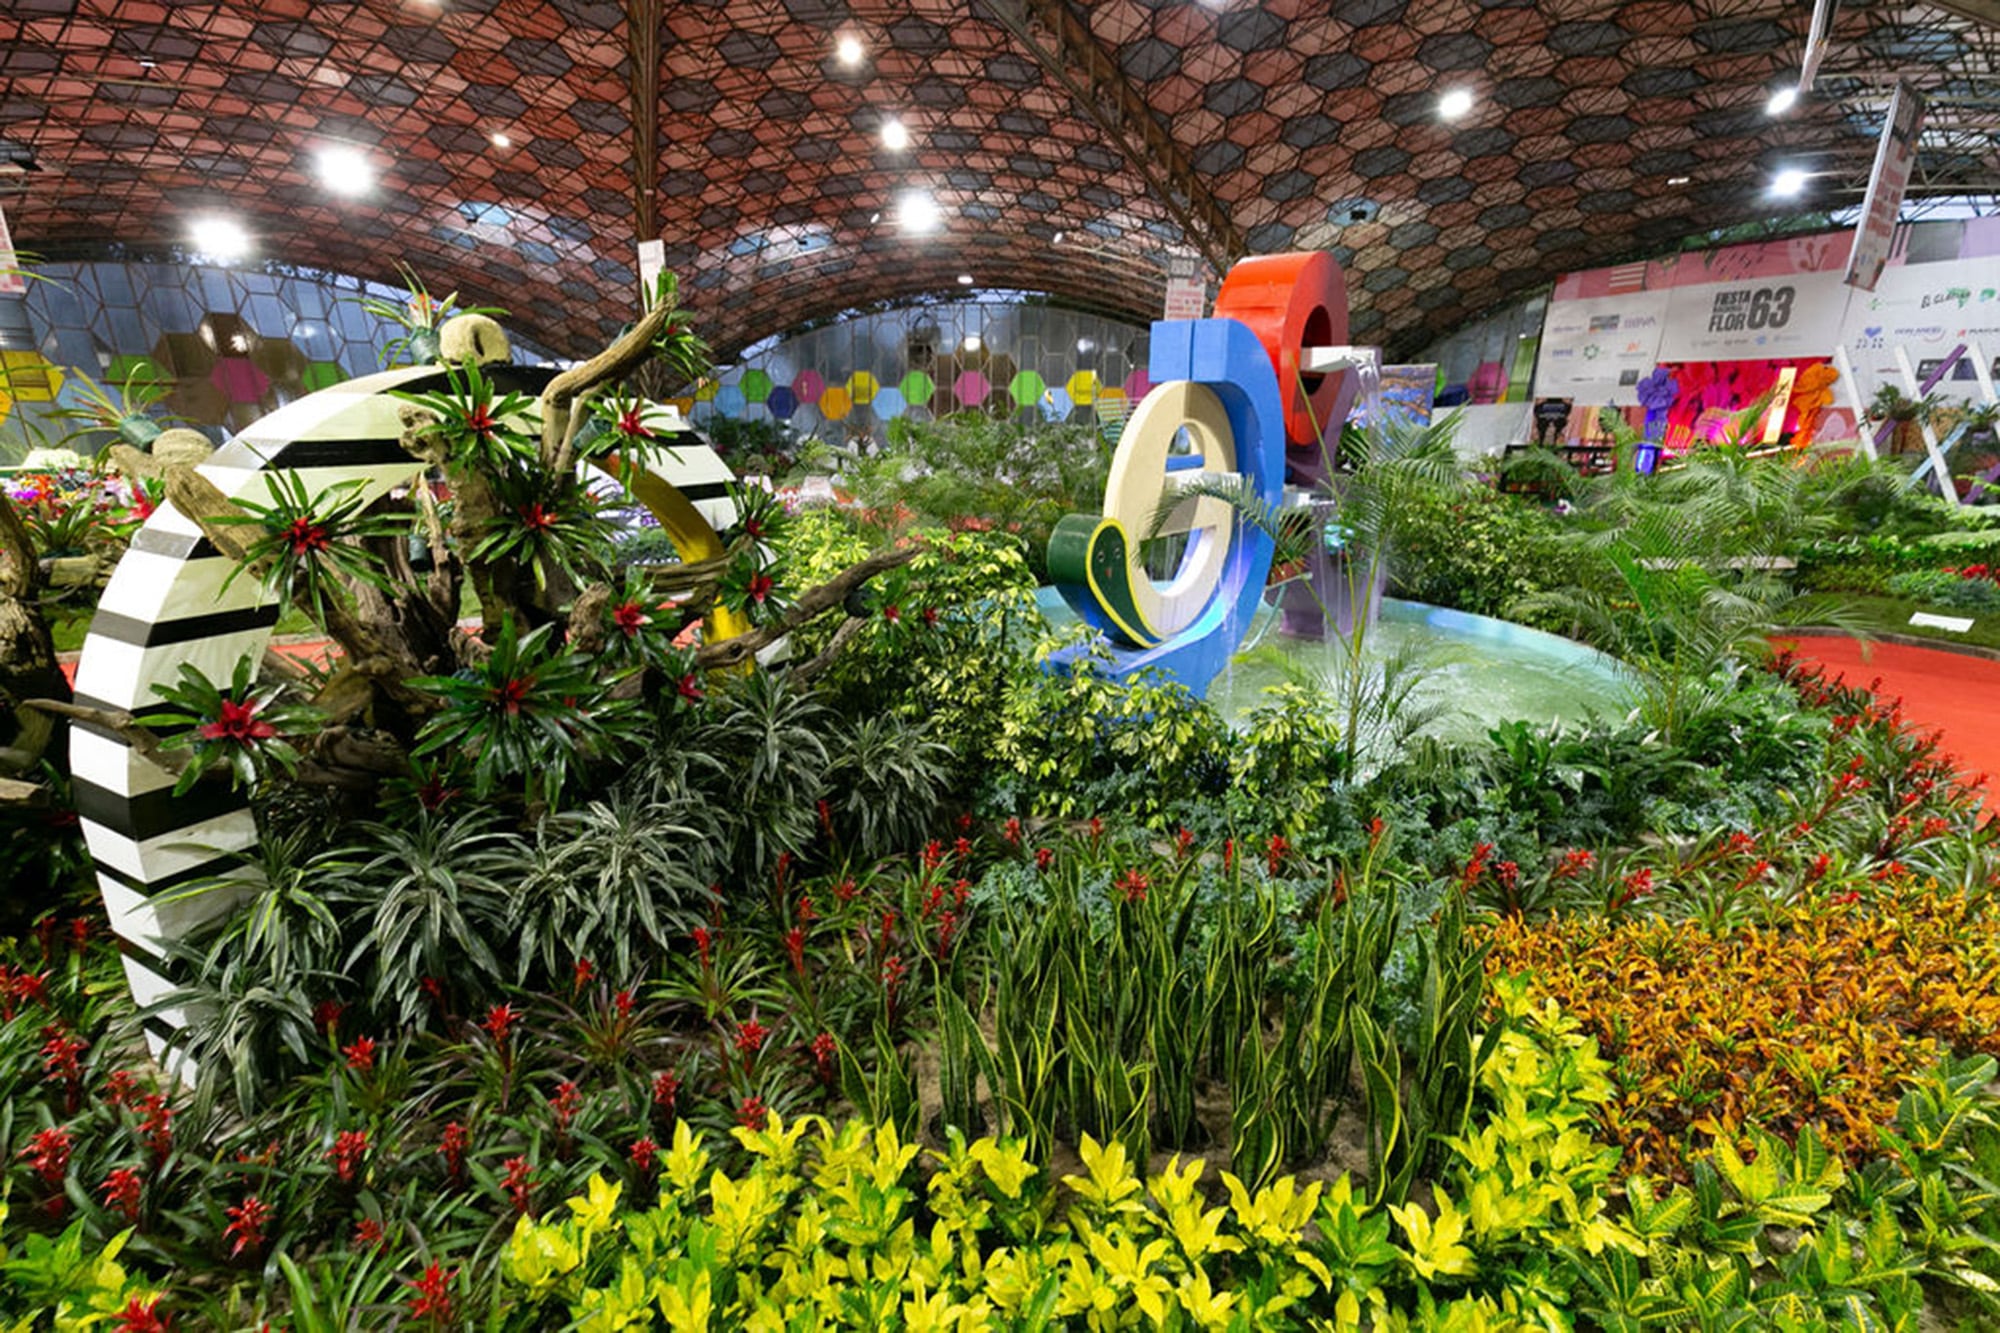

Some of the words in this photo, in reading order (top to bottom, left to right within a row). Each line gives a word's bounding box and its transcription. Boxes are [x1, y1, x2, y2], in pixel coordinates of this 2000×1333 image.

[1714, 290, 1751, 305] FIESTA
[1747, 286, 1796, 329] 63
[1708, 313, 1747, 332] FLOR
